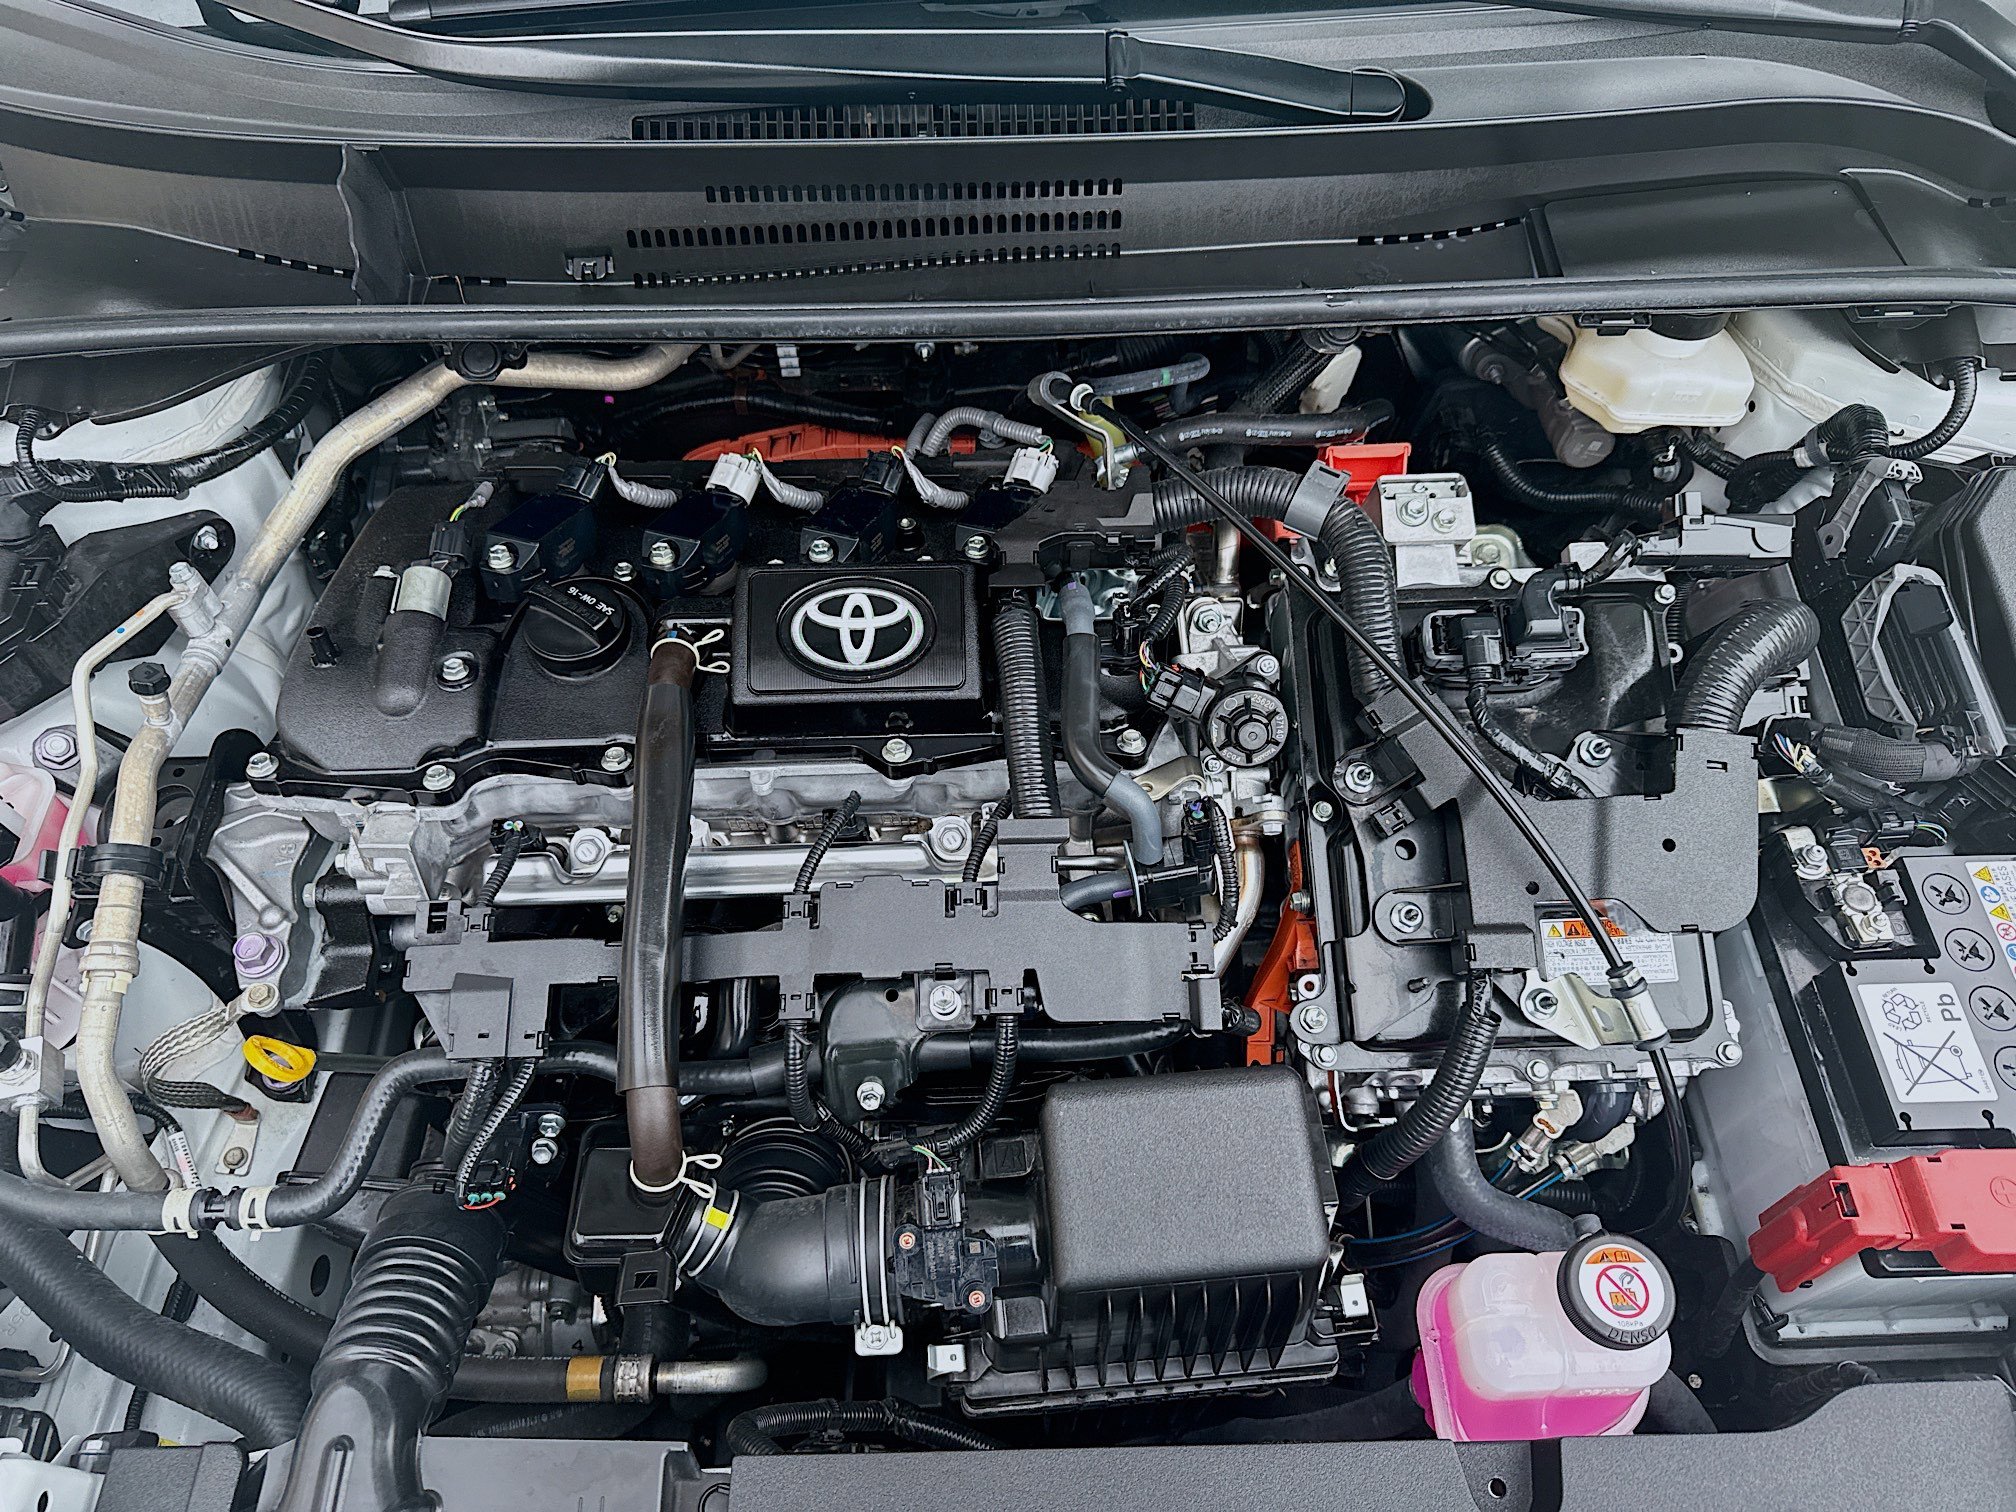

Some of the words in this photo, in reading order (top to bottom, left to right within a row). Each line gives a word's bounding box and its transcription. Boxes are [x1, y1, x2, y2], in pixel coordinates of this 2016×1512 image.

[567, 586, 597, 605] 0W-16
[595, 600, 615, 616] SAE
[1251, 694, 1275, 710] 25620
[1275, 714, 1284, 739] 37140
[1253, 747, 1277, 763] TOYOTA
[1919, 1000, 1931, 1023] RECYCLE
[1937, 992, 1962, 1023] Pb
[1607, 1326, 1658, 1344] DENSO
[571, 1339, 585, 1351] 4
